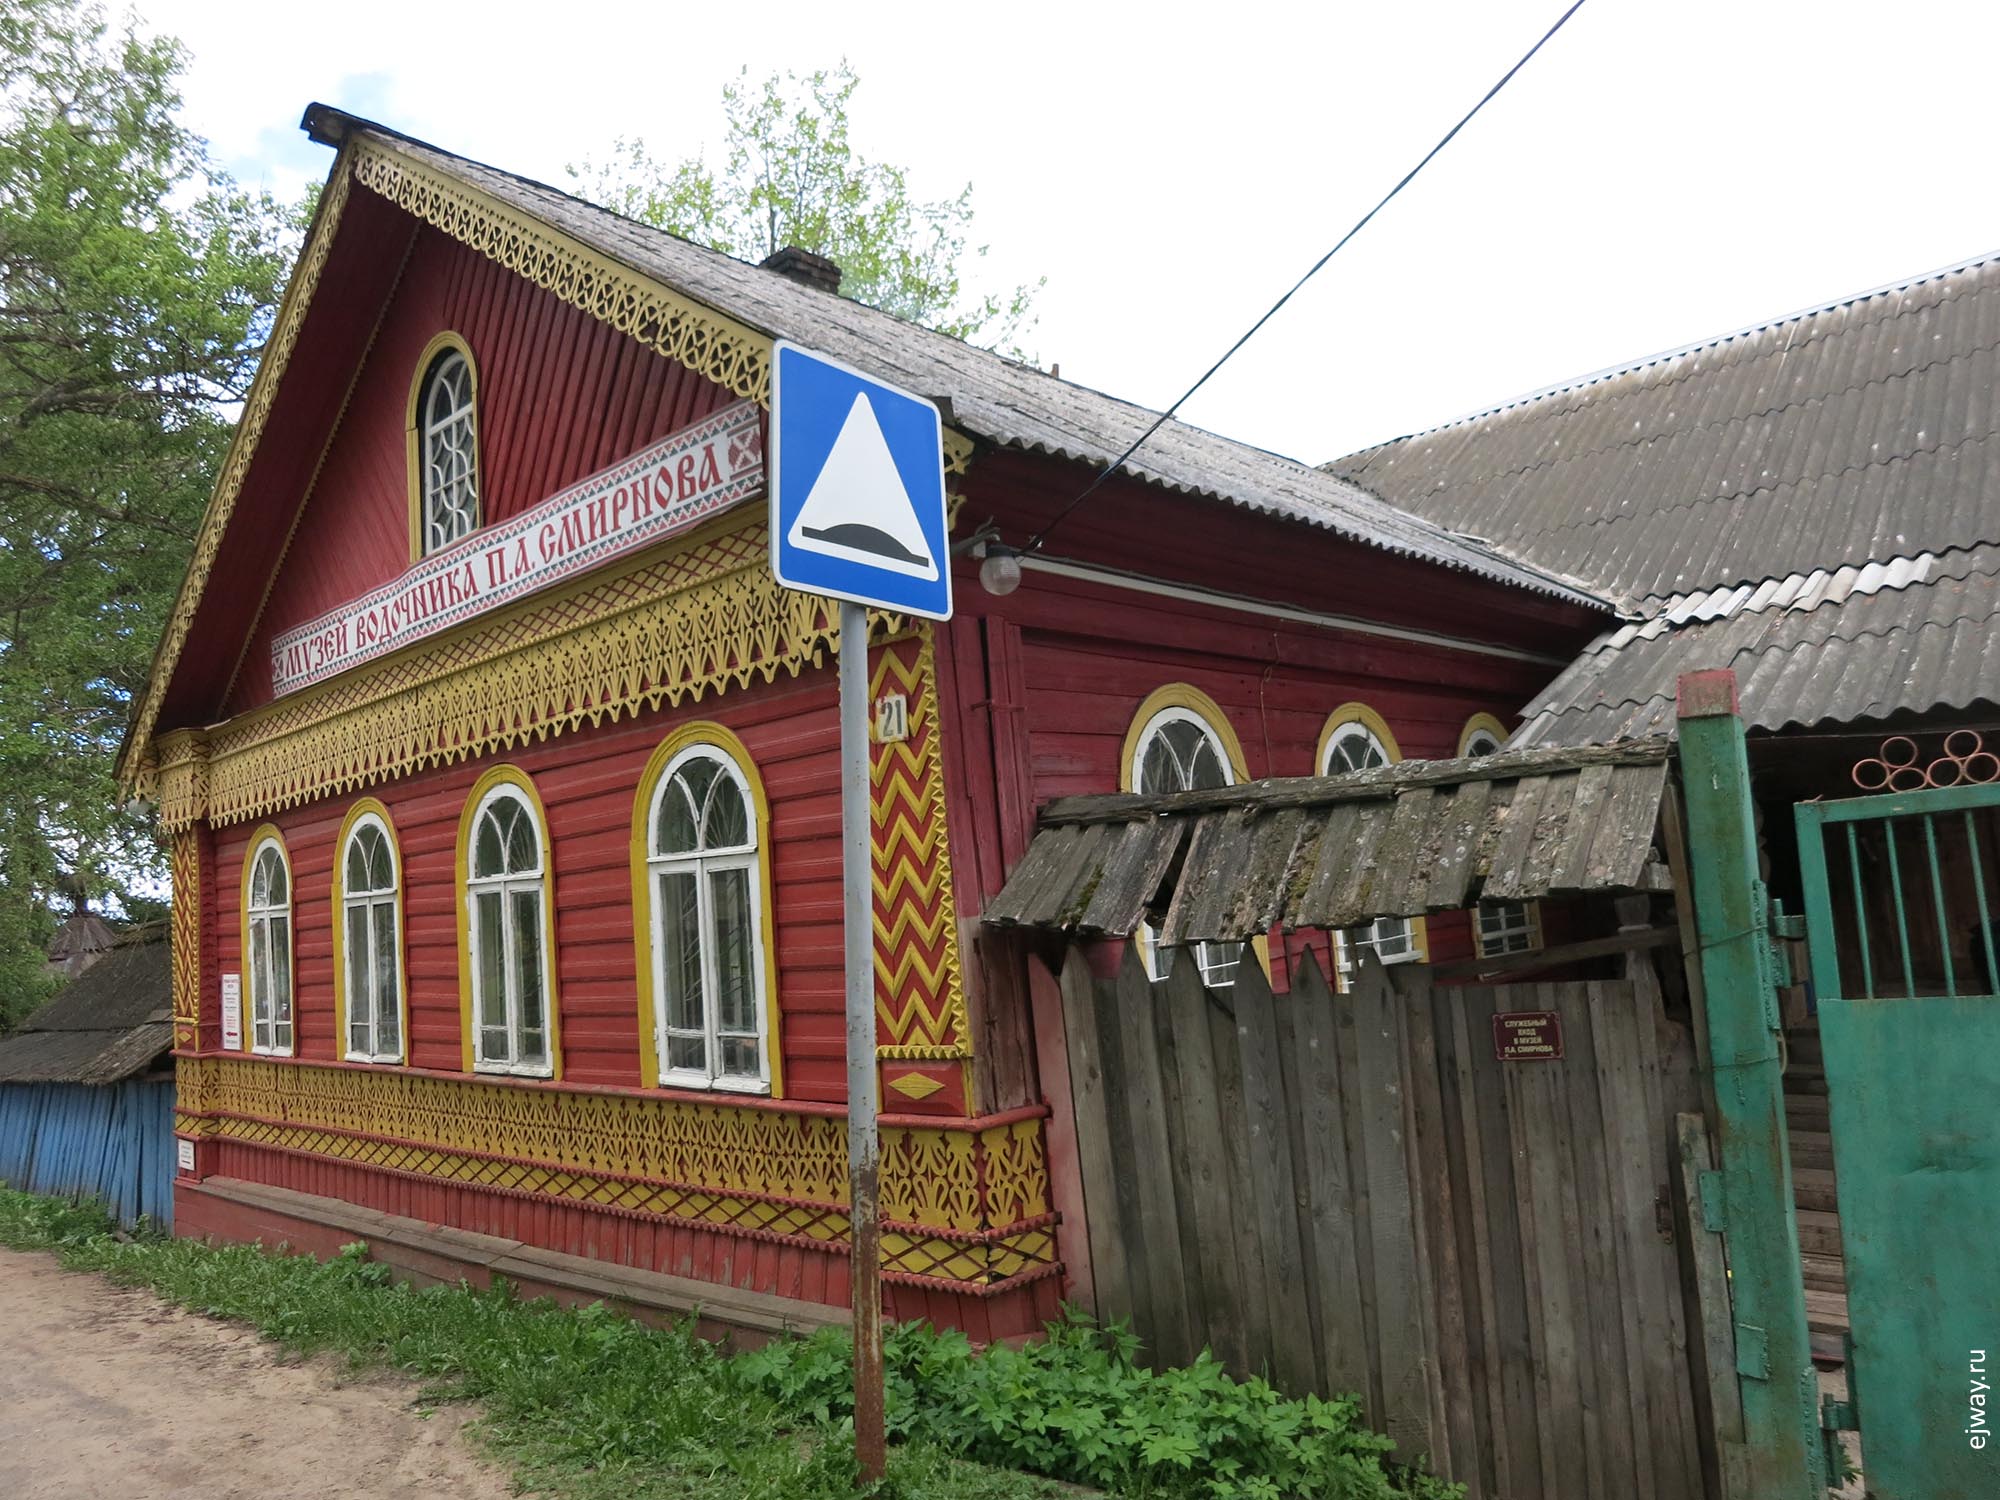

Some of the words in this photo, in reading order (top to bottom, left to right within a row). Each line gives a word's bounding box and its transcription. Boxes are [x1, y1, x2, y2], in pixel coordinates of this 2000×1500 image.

[286, 619, 349, 680] МУЗЕЙ
[355, 560, 479, 650] ВОДОЧНИКА
[485, 536, 536, 589] П.А.
[540, 442, 724, 565] СМИРНОВА
[880, 699, 902, 737] 21
[1504, 1019, 1547, 1028] СЛУЖЕБНЫЙ
[1517, 1028, 1536, 1036] ВХОД
[1519, 1036, 1542, 1045] МУЗЕЙ
[1517, 1045, 1553, 1053] СМИРНОВА
